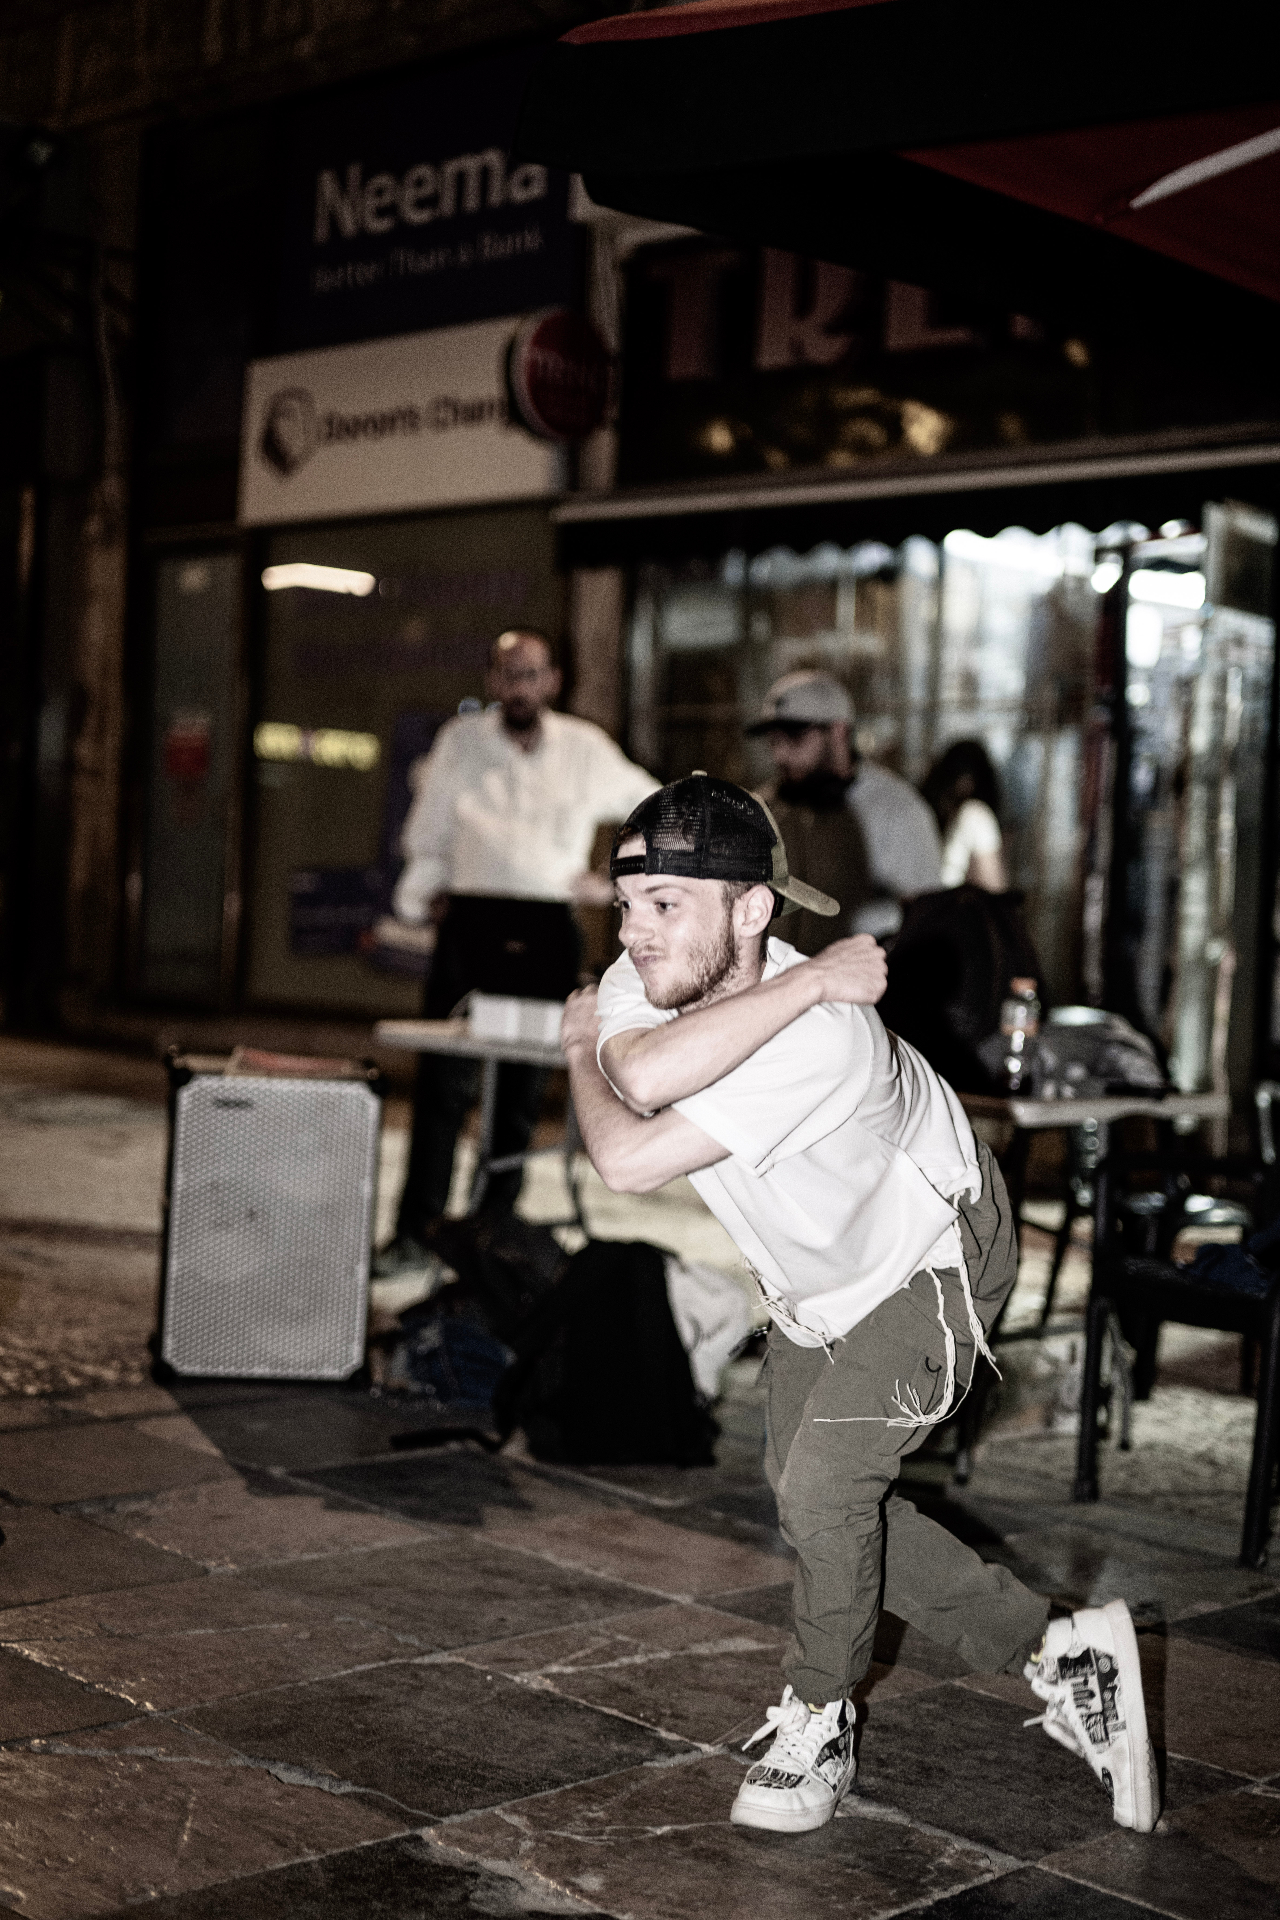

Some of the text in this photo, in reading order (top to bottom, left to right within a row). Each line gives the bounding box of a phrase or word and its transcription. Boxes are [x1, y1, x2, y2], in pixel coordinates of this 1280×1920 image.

[312, 147, 549, 246] Neema
[389, 246, 451, 276] Than
[478, 225, 545, 262] Bank
